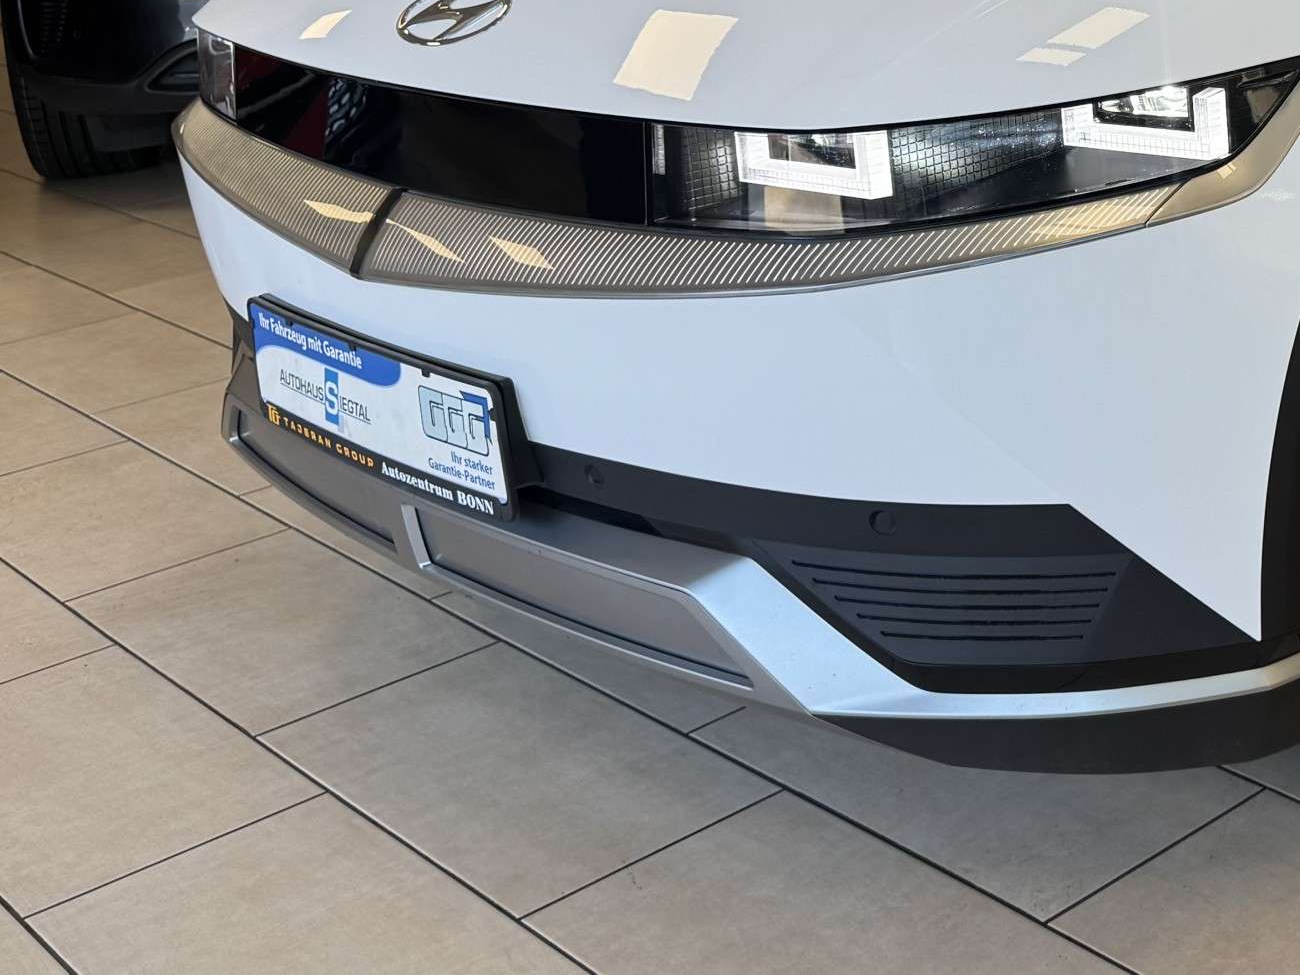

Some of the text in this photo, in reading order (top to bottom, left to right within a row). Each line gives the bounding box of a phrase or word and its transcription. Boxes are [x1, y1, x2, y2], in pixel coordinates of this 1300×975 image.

[258, 313, 362, 369] Ihr Fahrzeug mit Garantie
[280, 369, 324, 402] AUTOHAUS
[335, 443, 374, 467] GROUP
[451, 450, 493, 475] Ihr starker
[381, 462, 494, 515] Autozentrum BONN
[428, 457, 495, 490] Garantie-Partner
